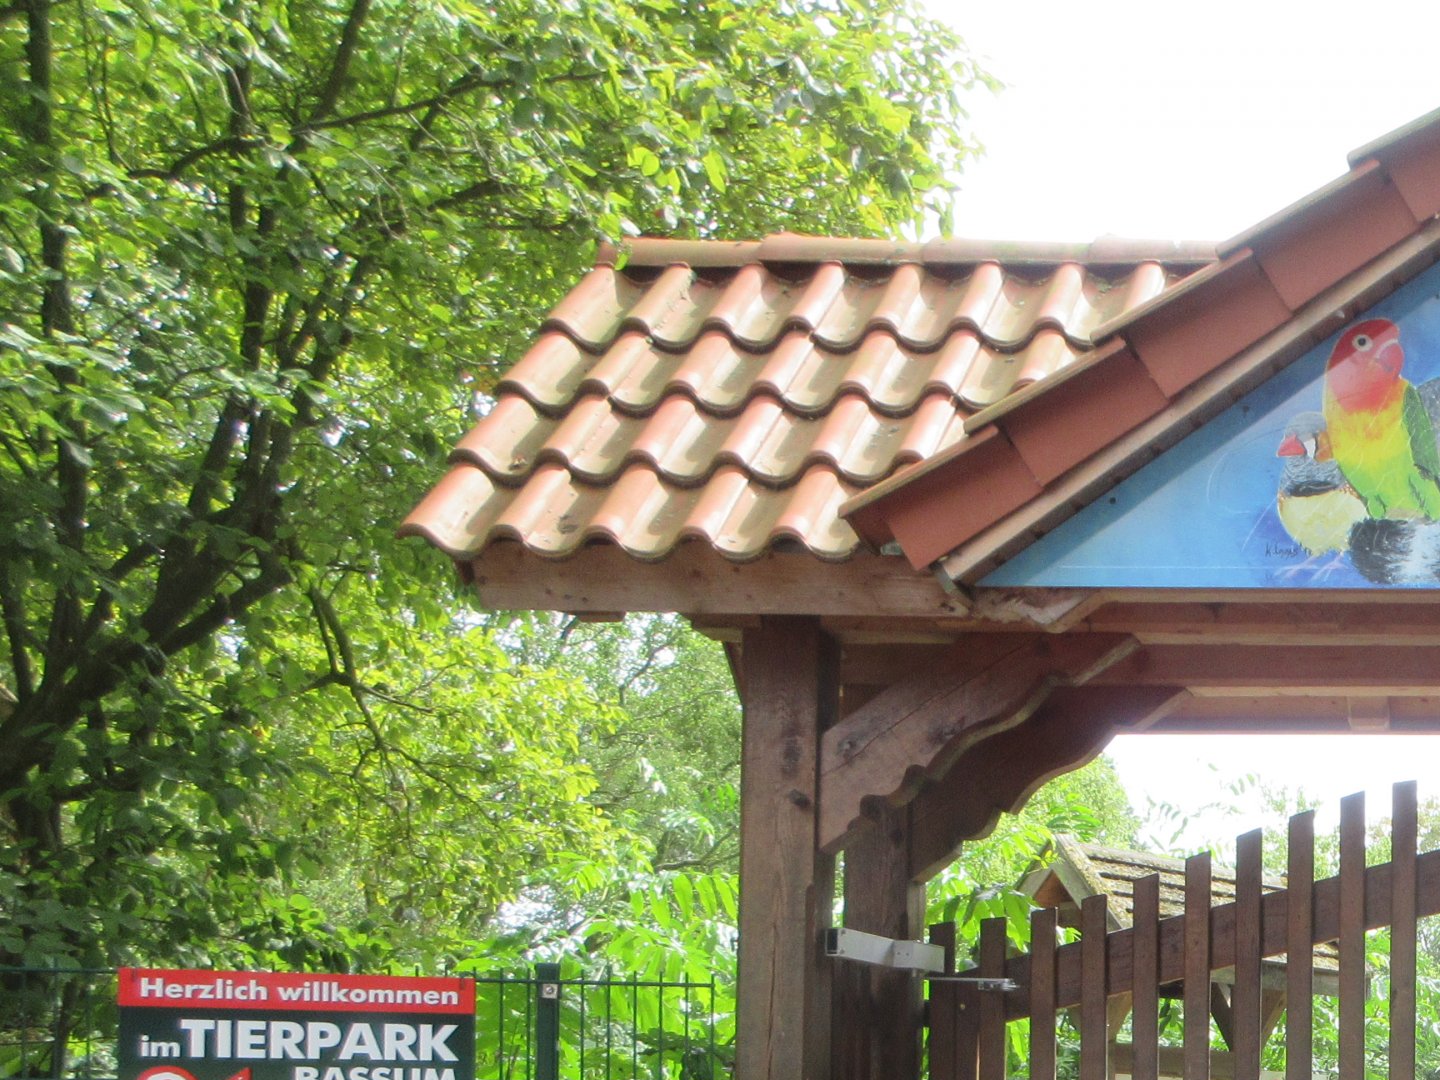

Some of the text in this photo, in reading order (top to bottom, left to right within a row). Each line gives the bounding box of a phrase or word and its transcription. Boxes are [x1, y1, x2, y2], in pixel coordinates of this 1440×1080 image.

[139, 977, 459, 1005] Herzlich willkommen
[140, 1018, 460, 1062] im TIERPARK
